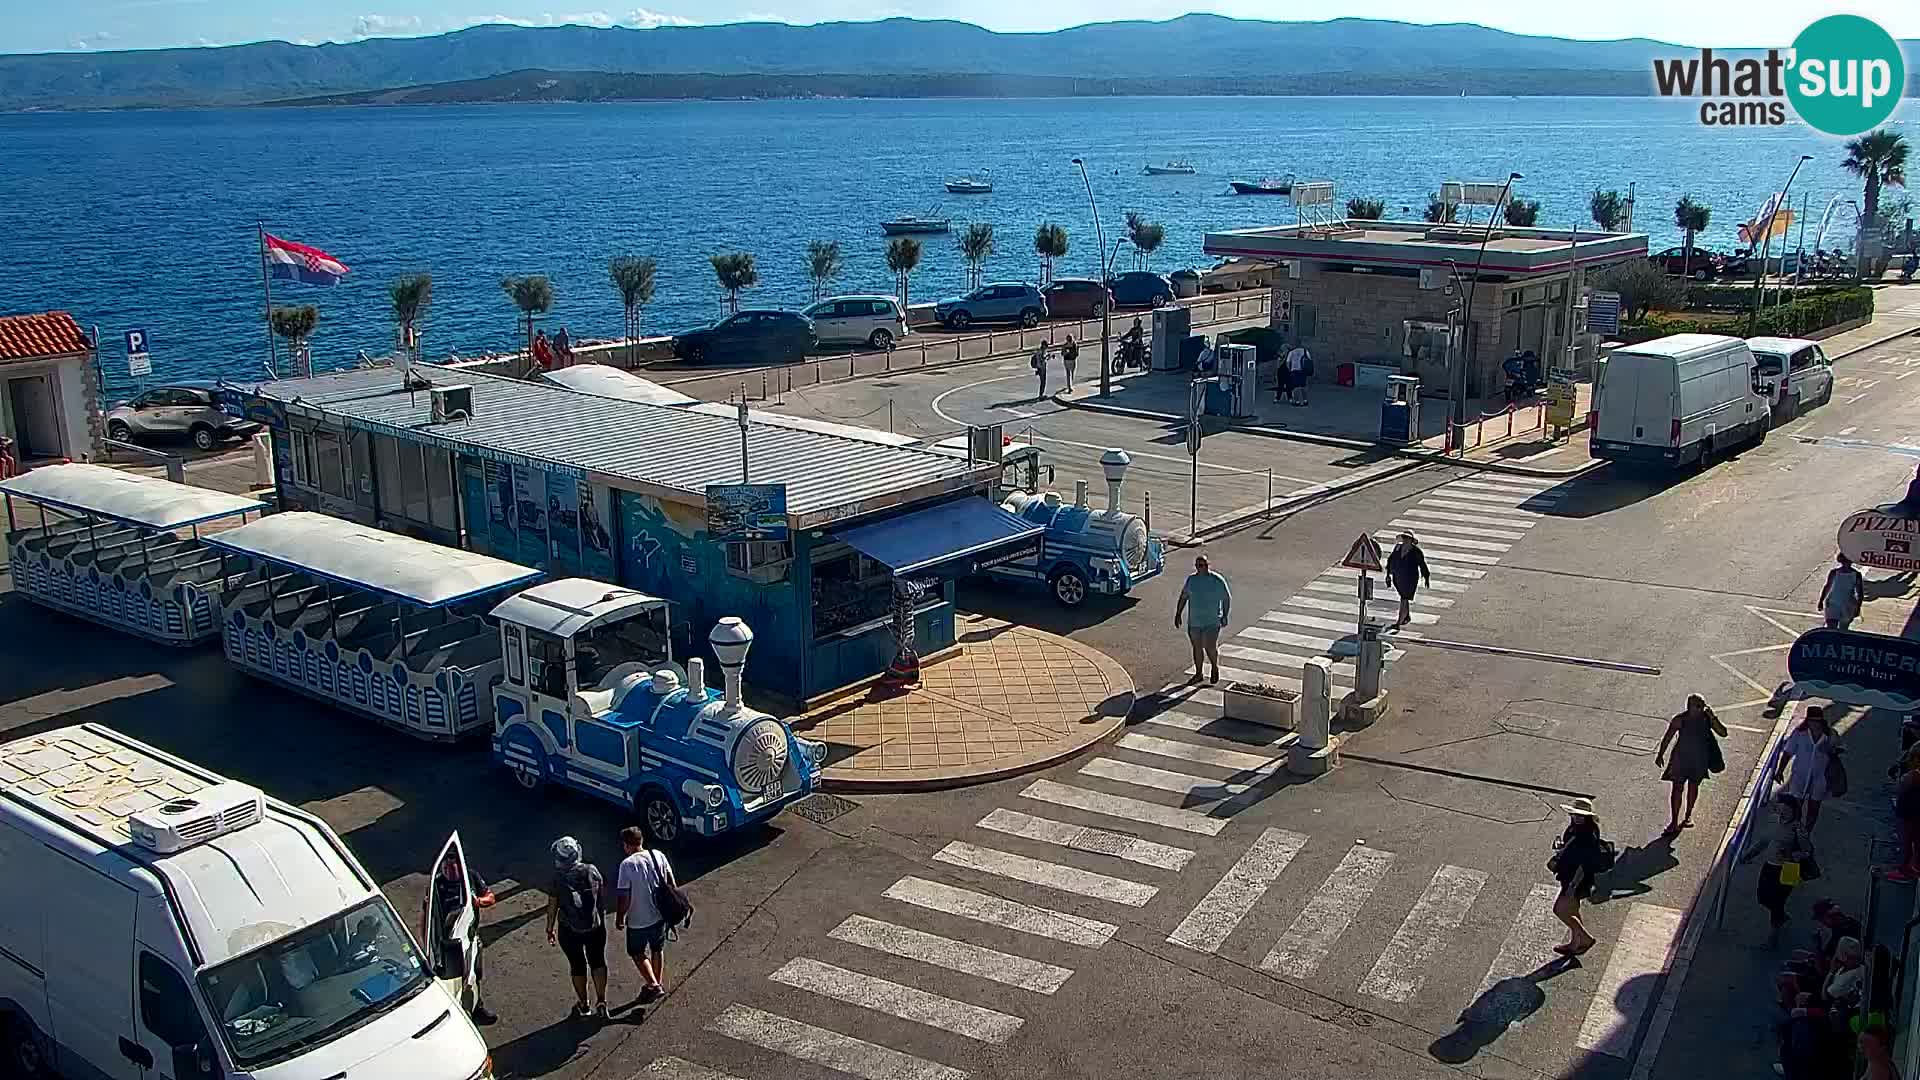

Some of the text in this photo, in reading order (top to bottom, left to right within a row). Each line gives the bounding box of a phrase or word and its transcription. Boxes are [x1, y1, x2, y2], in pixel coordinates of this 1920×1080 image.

[129, 332, 143, 352] P
[478, 447, 493, 459] BUS
[494, 451, 526, 467] STATION
[529, 458, 554, 473] TICKET
[555, 463, 583, 478] OFFICE
[1847, 515, 1920, 534] PIZZE
[1801, 643, 1920, 673] MARINER
[1871, 667, 1897, 681] bar
